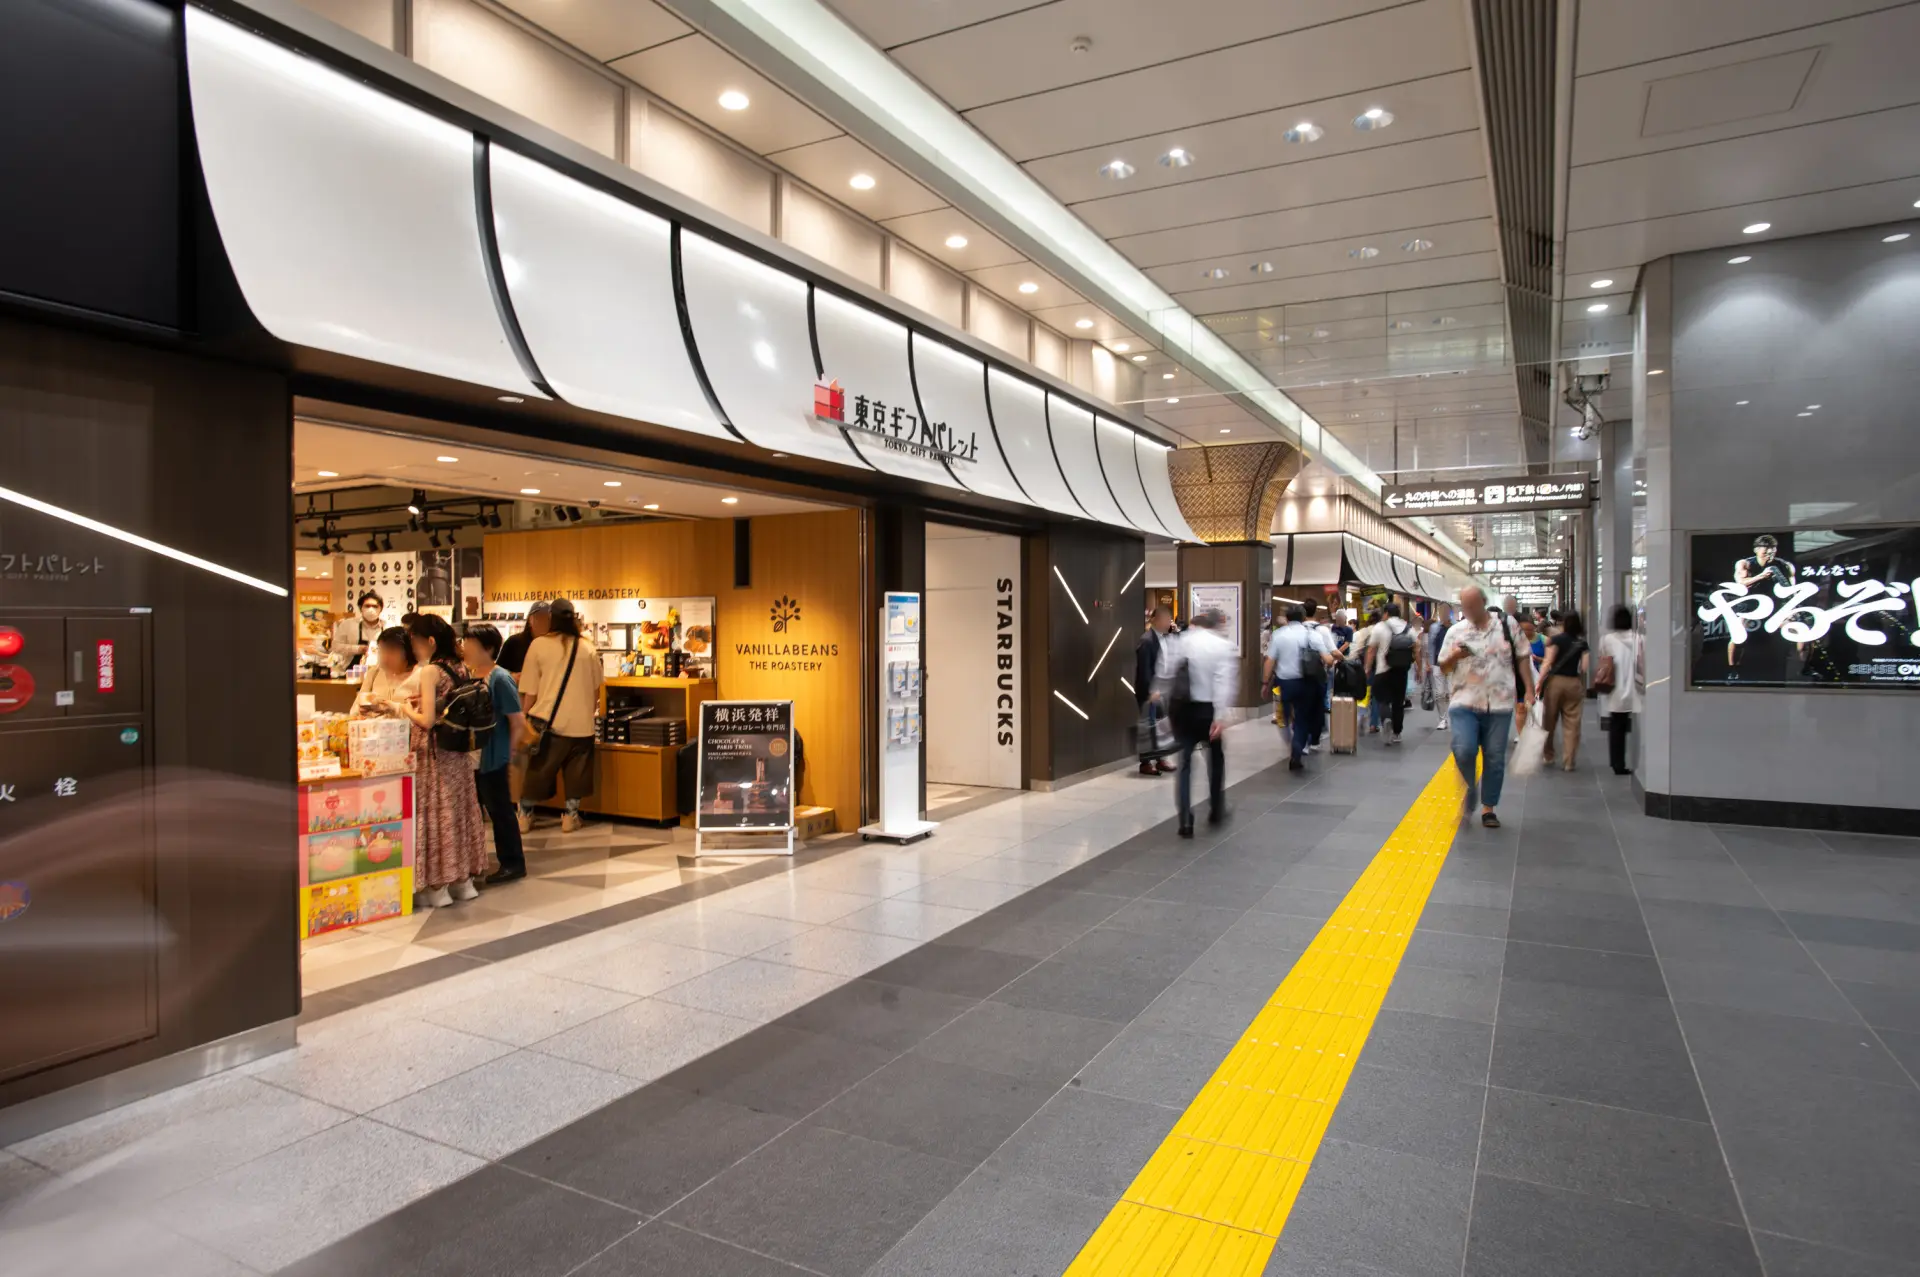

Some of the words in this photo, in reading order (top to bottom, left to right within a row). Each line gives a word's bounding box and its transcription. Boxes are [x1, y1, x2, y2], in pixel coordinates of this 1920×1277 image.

[854, 395, 979, 459] 東京ギフトパレット
[884, 437, 908, 453] TOKYO
[0, 553, 105, 575] フトパレット
[1801, 564, 1861, 577] みんなで
[491, 591, 562, 601] VANILLABEANS
[566, 590, 585, 600] THE
[588, 588, 640, 600] ROASTERY
[735, 643, 839, 656] VANILLABEANS
[749, 660, 768, 671] THE
[771, 661, 822, 671] ROASTERY
[996, 578, 1014, 747] STARBUCKS
[714, 707, 779, 722] 横浜発祥
[708, 723, 786, 732] クラフトチョコレート専門店
